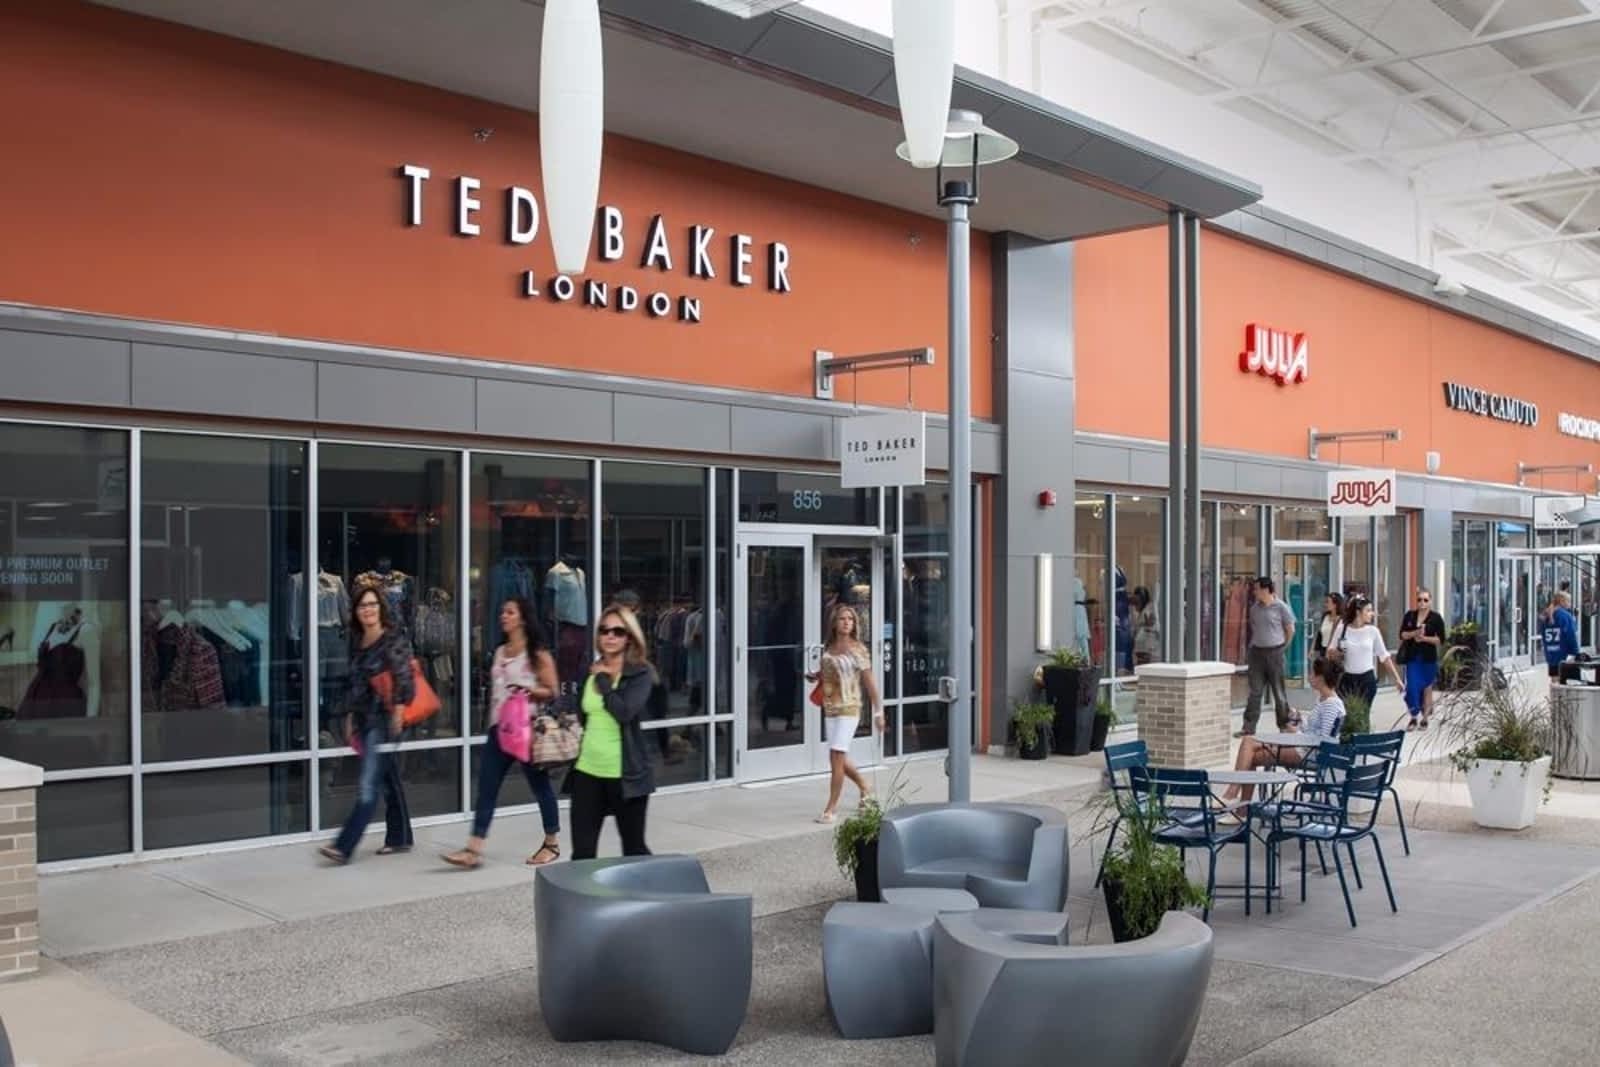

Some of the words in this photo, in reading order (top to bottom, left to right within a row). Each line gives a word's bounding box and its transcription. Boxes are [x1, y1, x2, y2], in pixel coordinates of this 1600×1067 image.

[402, 164, 540, 245] TED
[598, 204, 792, 293] BAKER
[525, 270, 700, 321] LONDON
[1241, 324, 1309, 386] JULIA
[1444, 381, 1489, 417] VINCE
[1489, 393, 1539, 427] CAMUTO
[1558, 412, 1600, 441] ROCKP
[847, 441, 868, 452] TED
[877, 438, 915, 450] BAKER
[793, 489, 822, 510] 856
[1331, 479, 1390, 506] JULIA
[7, 556, 61, 569] PREMIUM
[66, 557, 109, 570] OUTLET
[1545, 628, 1561, 642] 57
